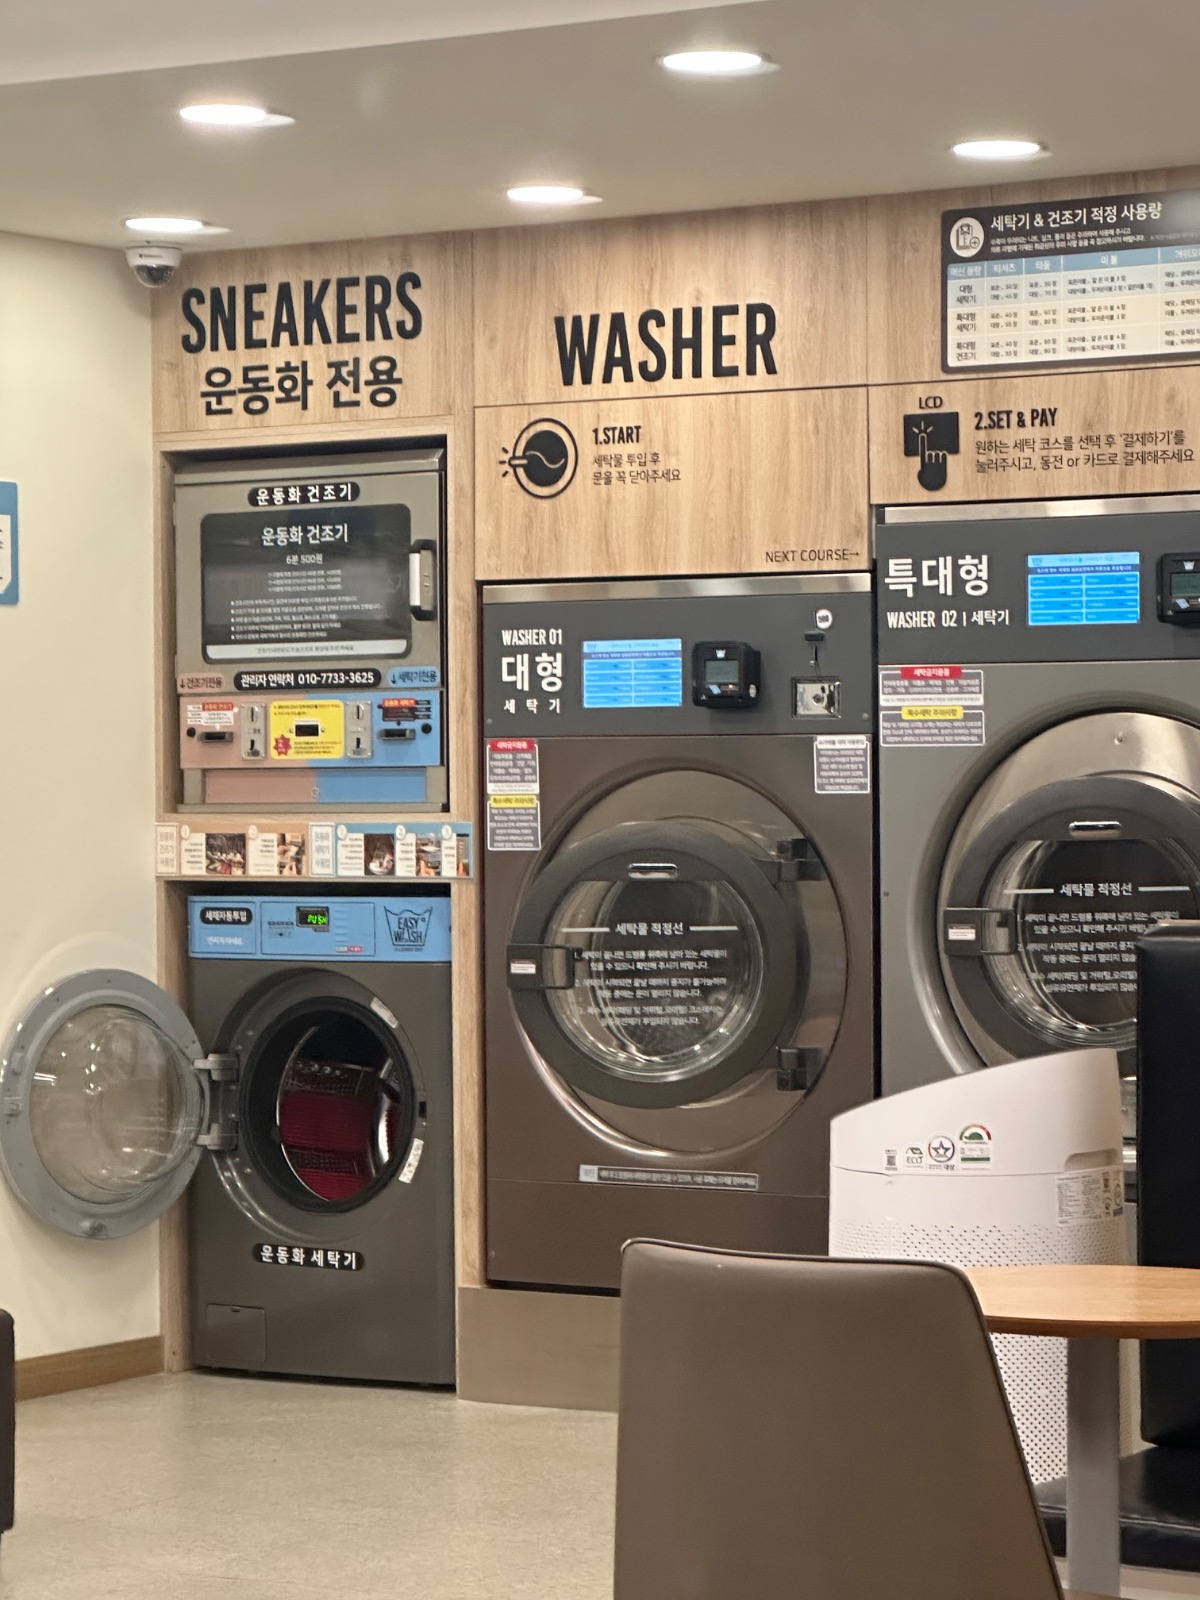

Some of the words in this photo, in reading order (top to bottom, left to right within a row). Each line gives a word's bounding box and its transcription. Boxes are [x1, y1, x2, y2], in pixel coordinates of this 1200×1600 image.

[990, 213, 1030, 232] 세탁기
[1034, 213, 1045, 226] &
[1047, 208, 1087, 228] 건조기
[1090, 205, 1117, 224] 적정
[1121, 201, 1163, 221] 사용량
[993, 263, 1017, 274] 티셔츠
[959, 284, 973, 294] 대형
[956, 295, 976, 304] 세탁기
[181, 271, 423, 354] SNEAKERS
[956, 312, 976, 322] 특대형
[956, 322, 976, 332] 세탁기
[553, 302, 778, 387] WASHER
[956, 341, 976, 351] 특대형
[956, 352, 976, 361] 건조기
[200, 360, 314, 416] 운동화
[326, 354, 403, 409] 전용
[918, 396, 943, 410] LCD
[974, 410, 1013, 431] 2.SET
[1016, 411, 1026, 428] &
[1030, 407, 1058, 427] PAY
[592, 425, 642, 445] 1.START
[975, 440, 1010, 455] 원하는
[1012, 438, 1037, 453] 세탁
[1039, 436, 1074, 452] 코스를
[1077, 434, 1101, 450] 선택
[1104, 433, 1116, 448] 후
[592, 453, 623, 468] 세탁물
[626, 452, 647, 467] 투입
[649, 452, 661, 466] 후
[975, 458, 1036, 474] 눌러주시고,
[1039, 455, 1063, 470] 동전
[1067, 457, 1079, 469] or
[1083, 452, 1120, 468] 카드로
[1122, 448, 1194, 466] 결제해주세요
[592, 472, 612, 486] 문을
[615, 471, 627, 485] 꼭
[629, 468, 681, 484] 닫아주세요
[256, 485, 301, 506] 운동화
[307, 482, 353, 503] 건조기
[261, 525, 303, 546] 운동화
[306, 523, 349, 544] 건조기
[286, 554, 299, 565] 6분
[300, 553, 323, 565] 500원
[765, 549, 796, 563] NEXT
[800, 548, 850, 562] COURSE
[884, 554, 989, 599] 특대형
[887, 610, 936, 629] WASHER
[941, 609, 958, 628] 02
[971, 609, 1010, 626] 세탁기
[501, 629, 546, 646] WASHER
[549, 628, 563, 645] 01
[240, 673, 267, 687] 관리자
[268, 672, 295, 686] 연락처
[297, 670, 374, 685] 010-7733-3625
[398, 670, 437, 683] 세탁기전용
[501, 651, 563, 693] 대형
[186, 676, 223, 689] 건조기전용
[503, 698, 561, 714] 세탁기
[1060, 883, 1095, 897] 세탁물
[1097, 882, 1133, 896] 적정선
[205, 909, 247, 922] 세제자동투입
[397, 917, 419, 931] EASY
[615, 922, 648, 936] 세탁물
[651, 922, 684, 936] 적정선
[393, 928, 423, 943] WASH
[261, 1245, 305, 1266] 운동화
[310, 1249, 357, 1270] 세탁기
